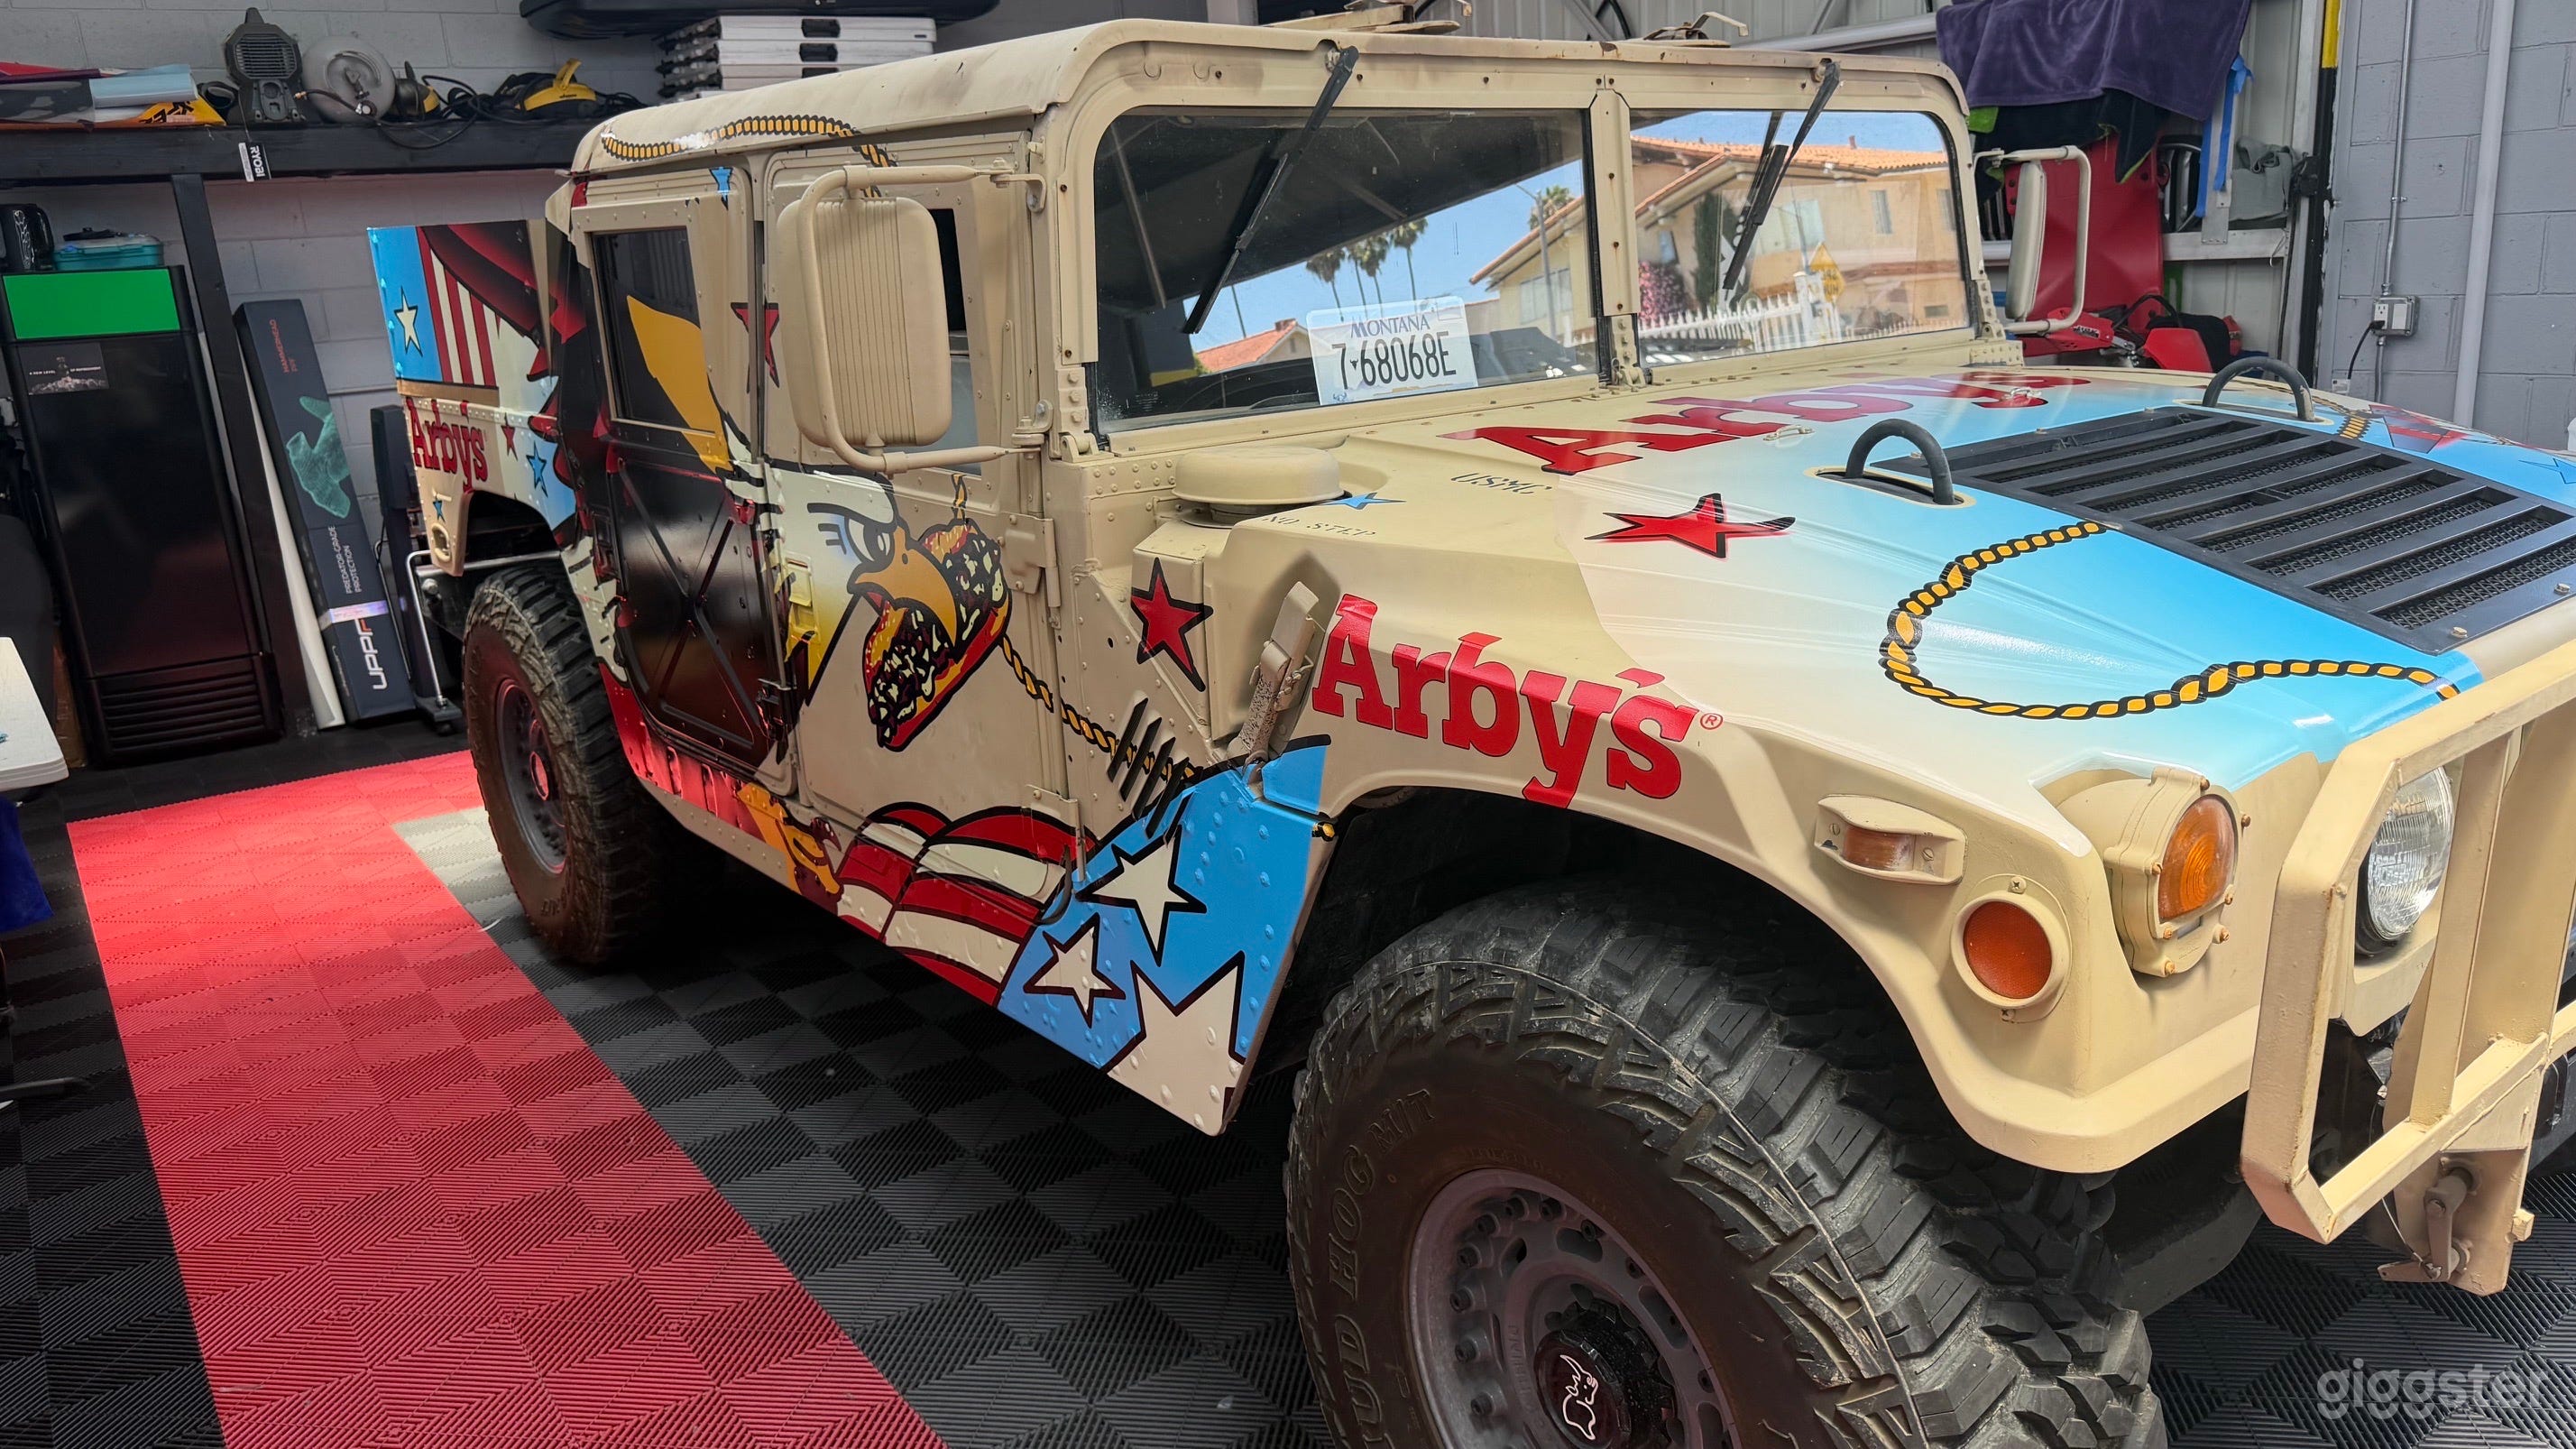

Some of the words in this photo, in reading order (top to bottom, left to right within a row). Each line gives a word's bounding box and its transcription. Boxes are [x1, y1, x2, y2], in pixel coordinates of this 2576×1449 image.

[250, 145, 265, 177] RYOBI
[1351, 315, 1431, 338] MONTANA
[406, 397, 488, 494] Arby's
[1436, 371, 2091, 476] Arby's
[1450, 473, 1552, 494] USMC
[1263, 515, 1300, 526] NO
[1307, 521, 1376, 537] STEP
[343, 545, 362, 593] PROTECTION
[1329, 1144, 1375, 1299] HOG
[1336, 1315, 1396, 1449] UD
